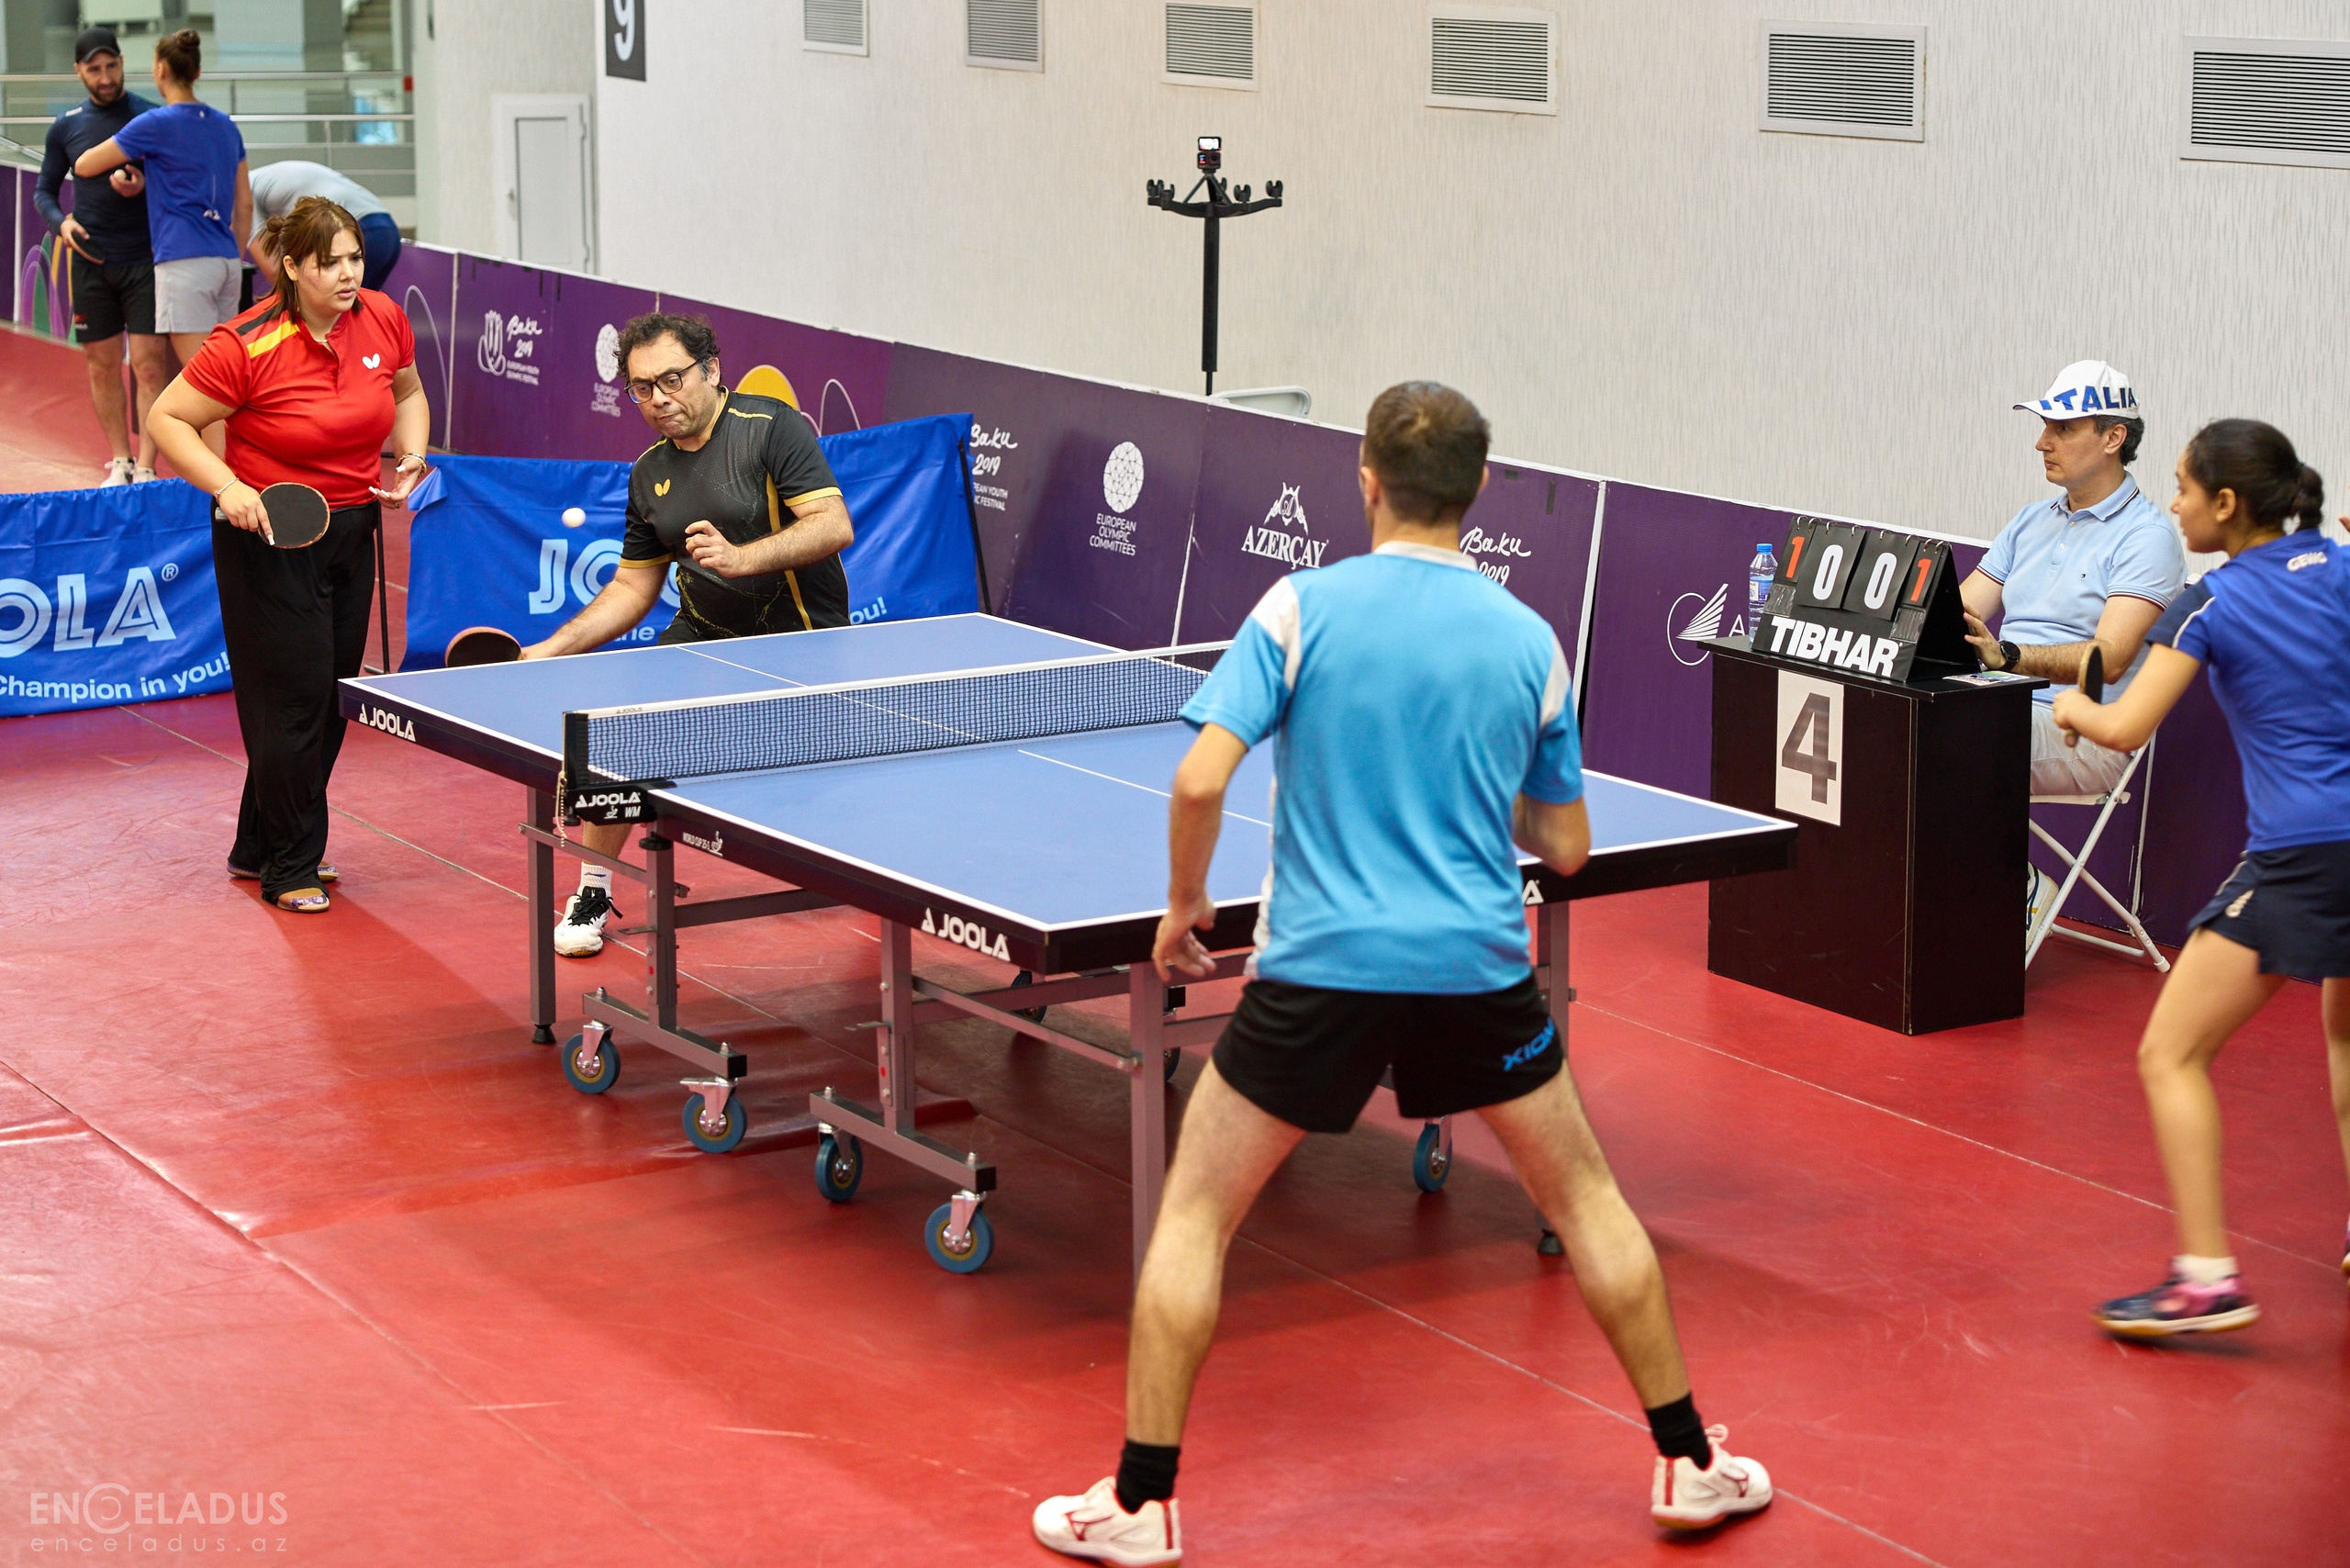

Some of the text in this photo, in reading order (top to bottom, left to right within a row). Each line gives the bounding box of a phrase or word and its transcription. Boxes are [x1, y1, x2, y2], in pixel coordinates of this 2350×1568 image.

[613, 0, 635, 62] 9
[2040, 386, 2137, 412] ITALIA
[969, 423, 1018, 449] Baku
[972, 454, 1001, 476] 2019
[1096, 513, 1136, 532] EUROPEAN
[1099, 526, 1130, 543] OLYMPIC
[1090, 535, 1136, 555] COMMITTEES
[1241, 525, 1326, 570] AZERÇAY
[1460, 526, 1531, 557] Baku
[1785, 536, 1805, 578] 1
[1812, 544, 1843, 600] 0
[1863, 552, 1897, 610] 0
[1910, 558, 1932, 602] 1
[1770, 616, 1899, 678] TIBHAR
[140, 677, 166, 697] in
[172, 651, 230, 694] you!
[369, 707, 416, 742] JOOLA
[1782, 692, 1837, 805] 4
[587, 791, 642, 807] JOOLA
[624, 806, 642, 818] WM
[937, 913, 1011, 962] JOOLA
